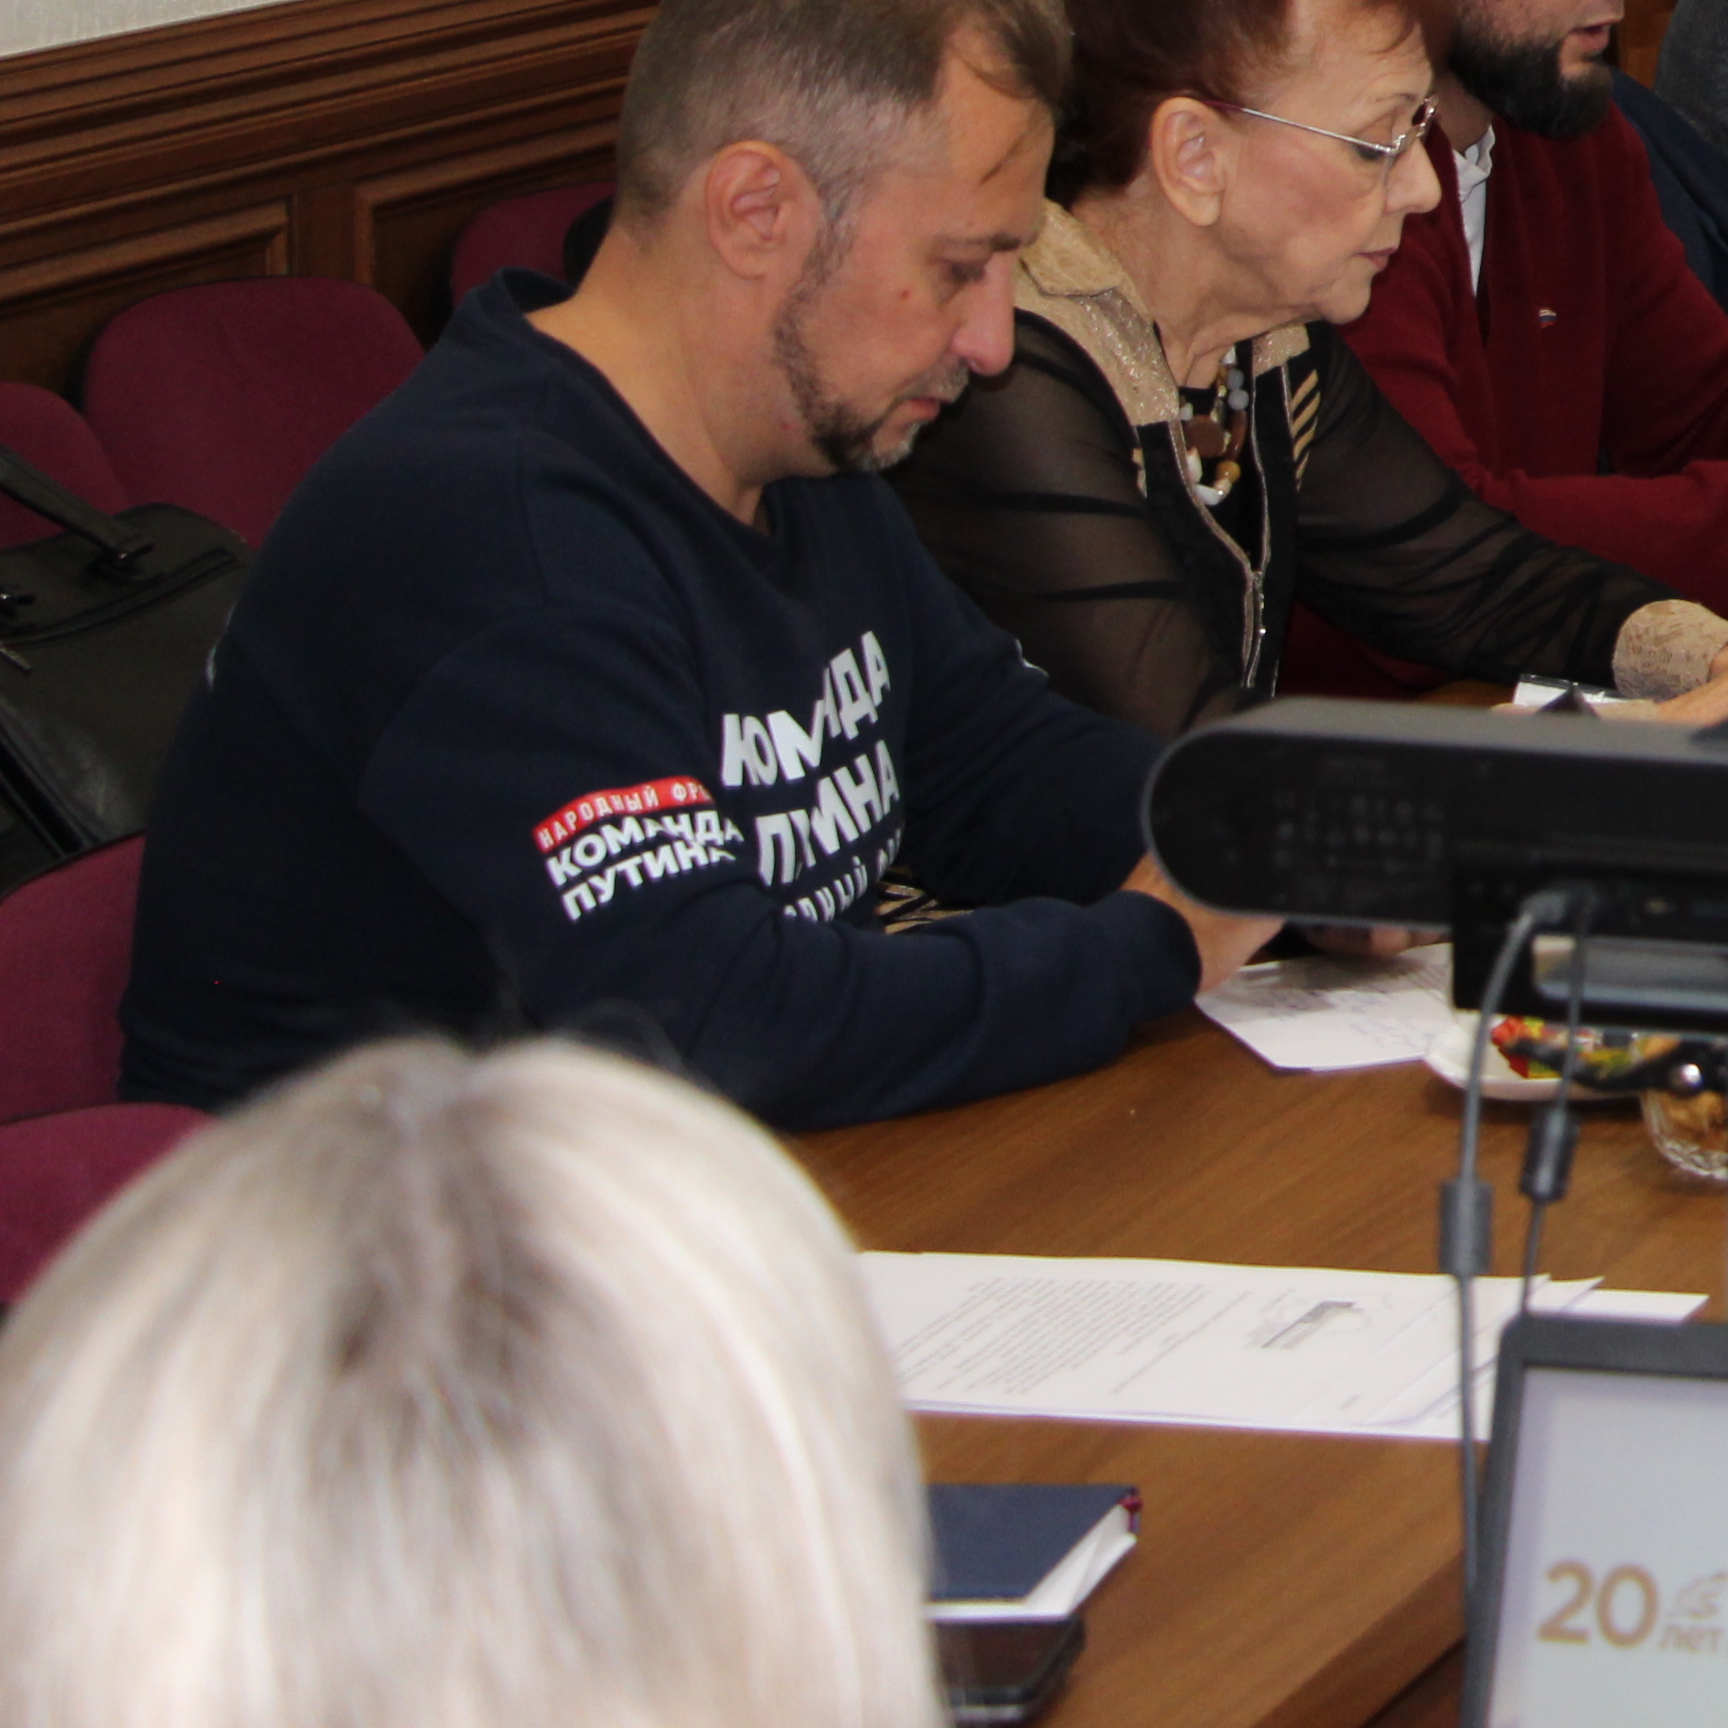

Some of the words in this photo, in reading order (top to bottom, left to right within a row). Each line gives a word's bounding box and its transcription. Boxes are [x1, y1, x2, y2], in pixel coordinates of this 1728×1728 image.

[537, 784, 660, 850] НАРОДНЫЙ
[546, 810, 745, 887] КОМАНДА
[562, 839, 737, 922] ПУТИНА
[1538, 1559, 1659, 1650] 20
